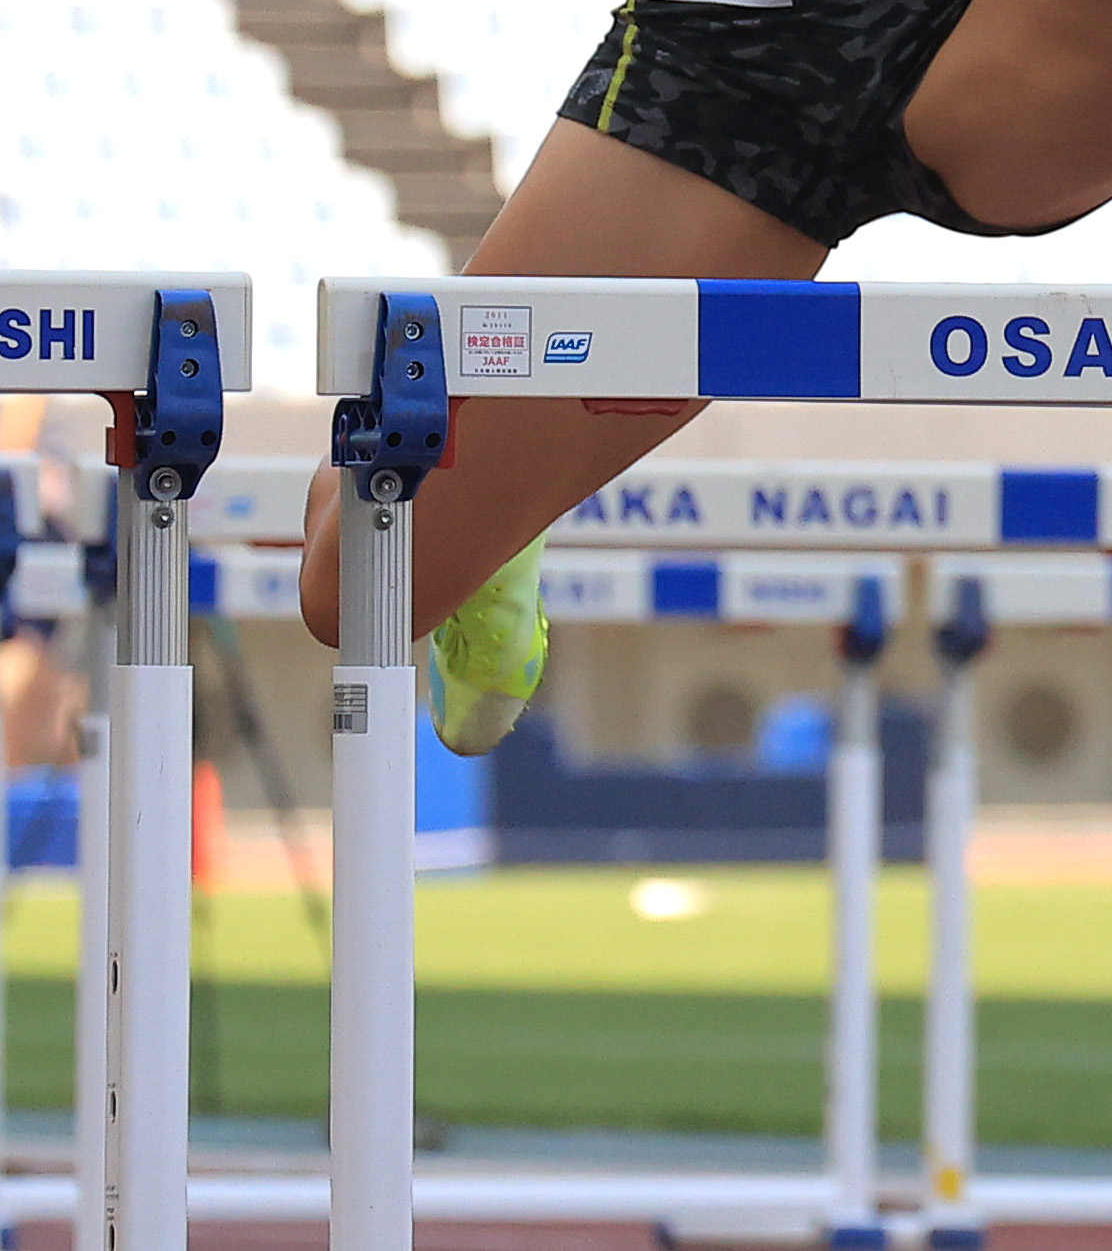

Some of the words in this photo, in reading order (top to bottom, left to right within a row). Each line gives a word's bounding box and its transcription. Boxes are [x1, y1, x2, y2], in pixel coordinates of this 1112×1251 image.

[0, 308, 95, 360] SHI
[550, 338, 588, 351] IAAF
[482, 356, 510, 367] JAAF
[577, 487, 702, 526] AKA
[750, 487, 952, 530] NAGAI
